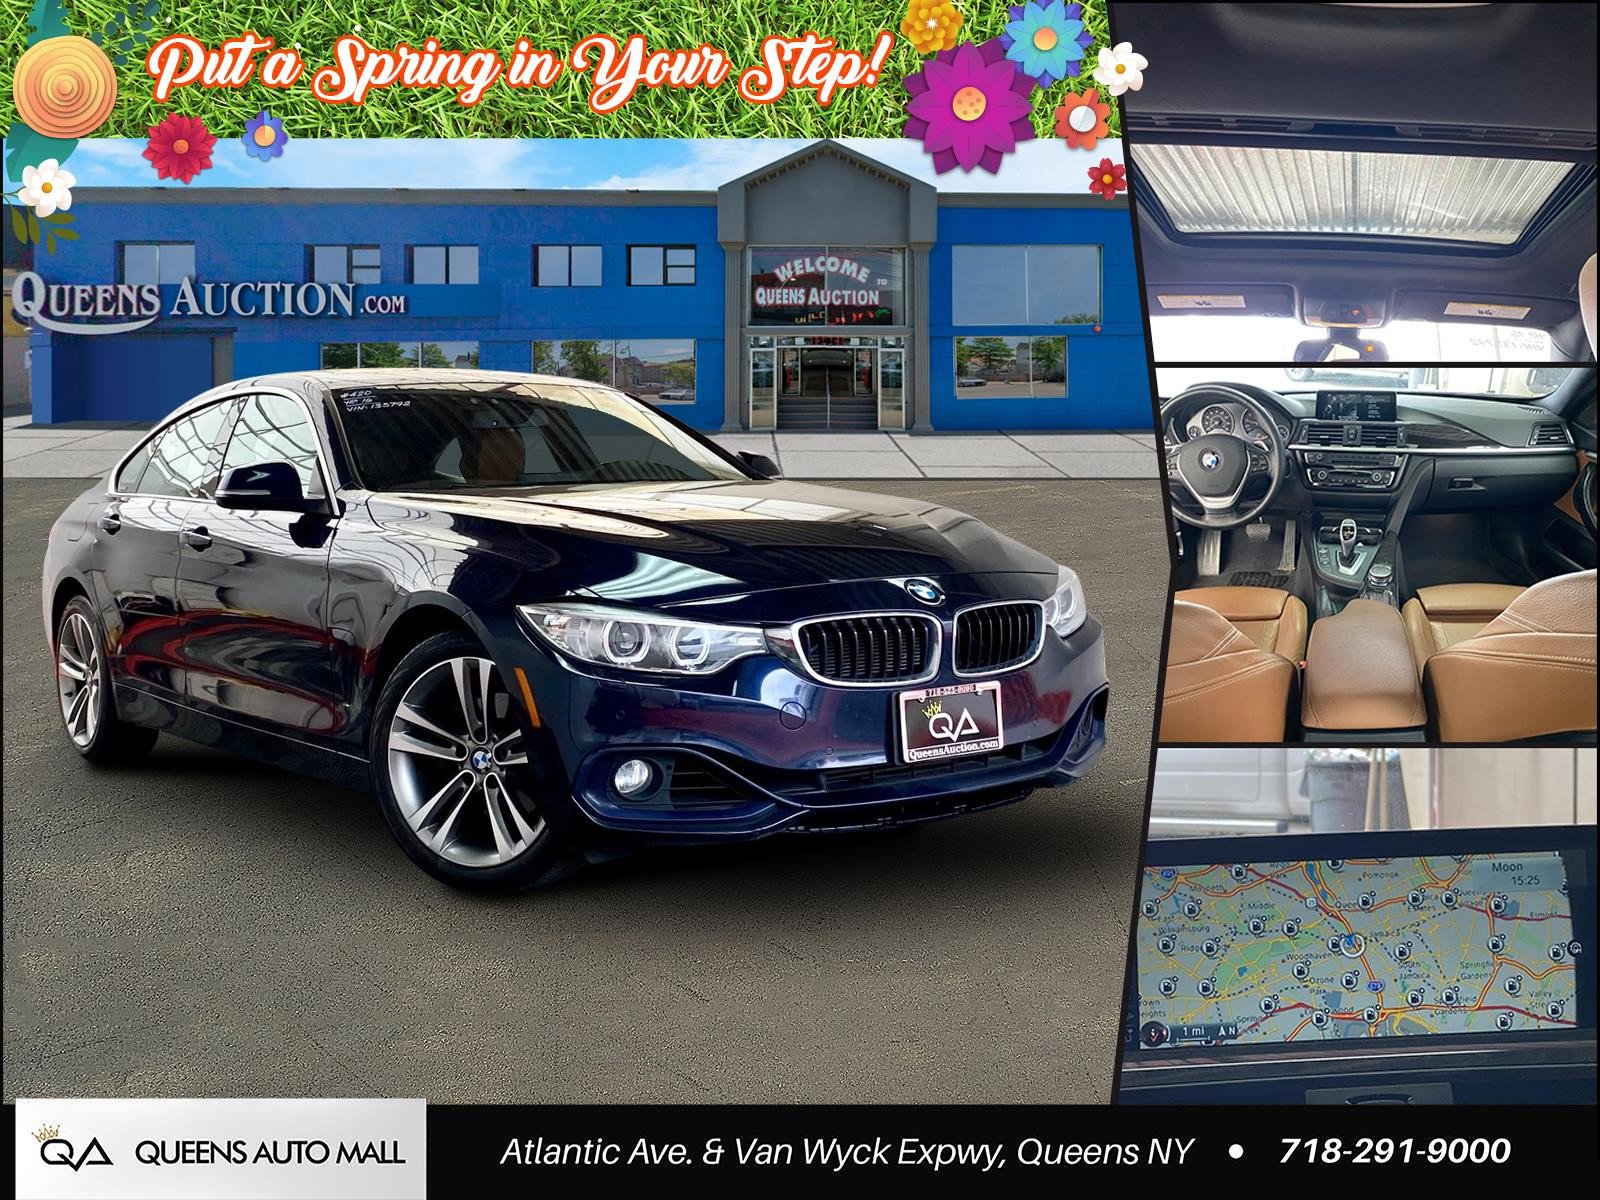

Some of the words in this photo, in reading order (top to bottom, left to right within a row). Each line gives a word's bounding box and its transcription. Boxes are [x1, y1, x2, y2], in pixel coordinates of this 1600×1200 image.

[774, 256, 871, 283] WELCOME
[755, 287, 805, 305] QUEENS
[808, 287, 879, 305] AUCTION
[12, 271, 161, 335] QUEENS
[909, 740, 999, 760] QueensAuction.com
[1492, 863, 1523, 872] Moon
[1512, 876, 1540, 885] 15:25
[1285, 952, 1333, 960] Woodhaven
[1191, 1027, 1205, 1036] mi
